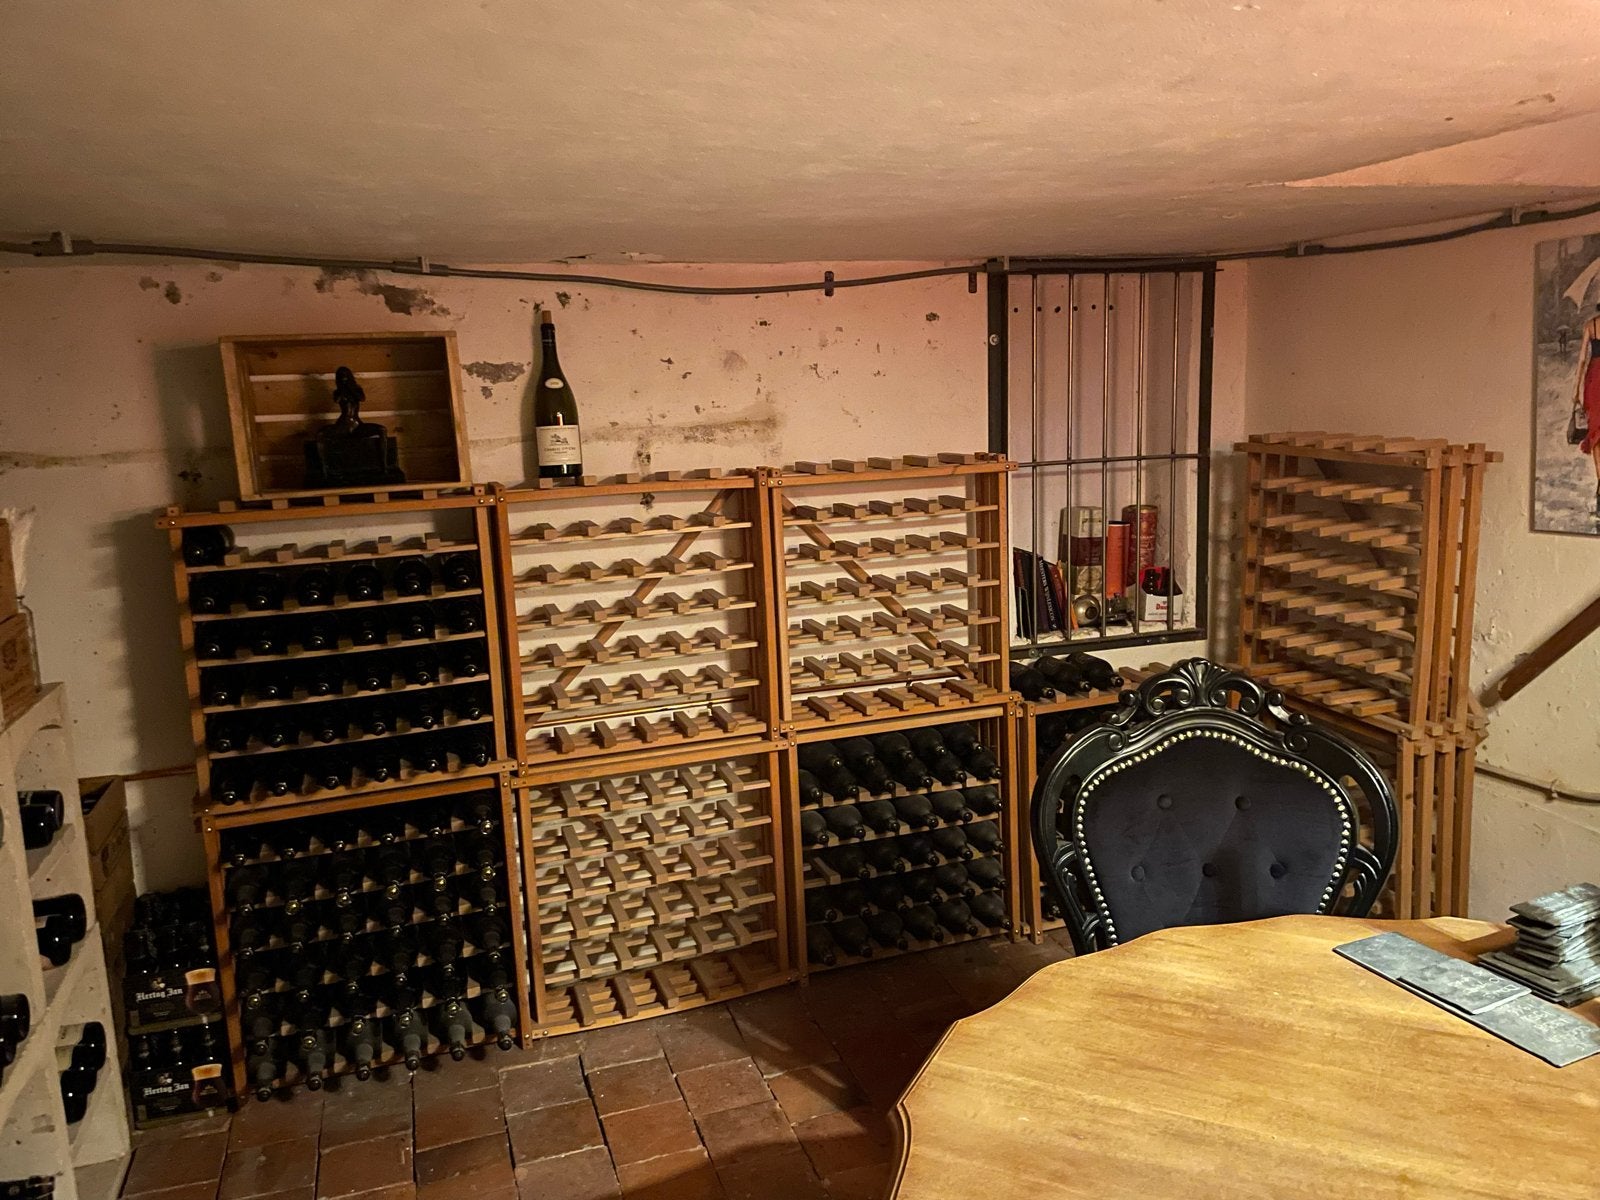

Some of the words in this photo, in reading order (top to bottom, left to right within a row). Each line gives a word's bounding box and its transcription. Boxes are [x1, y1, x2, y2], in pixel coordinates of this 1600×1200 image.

[136, 992, 165, 1003] Hertog
[166, 988, 183, 998] Jan
[143, 1085, 172, 1097] Hertog
[173, 1082, 189, 1092] Jan
